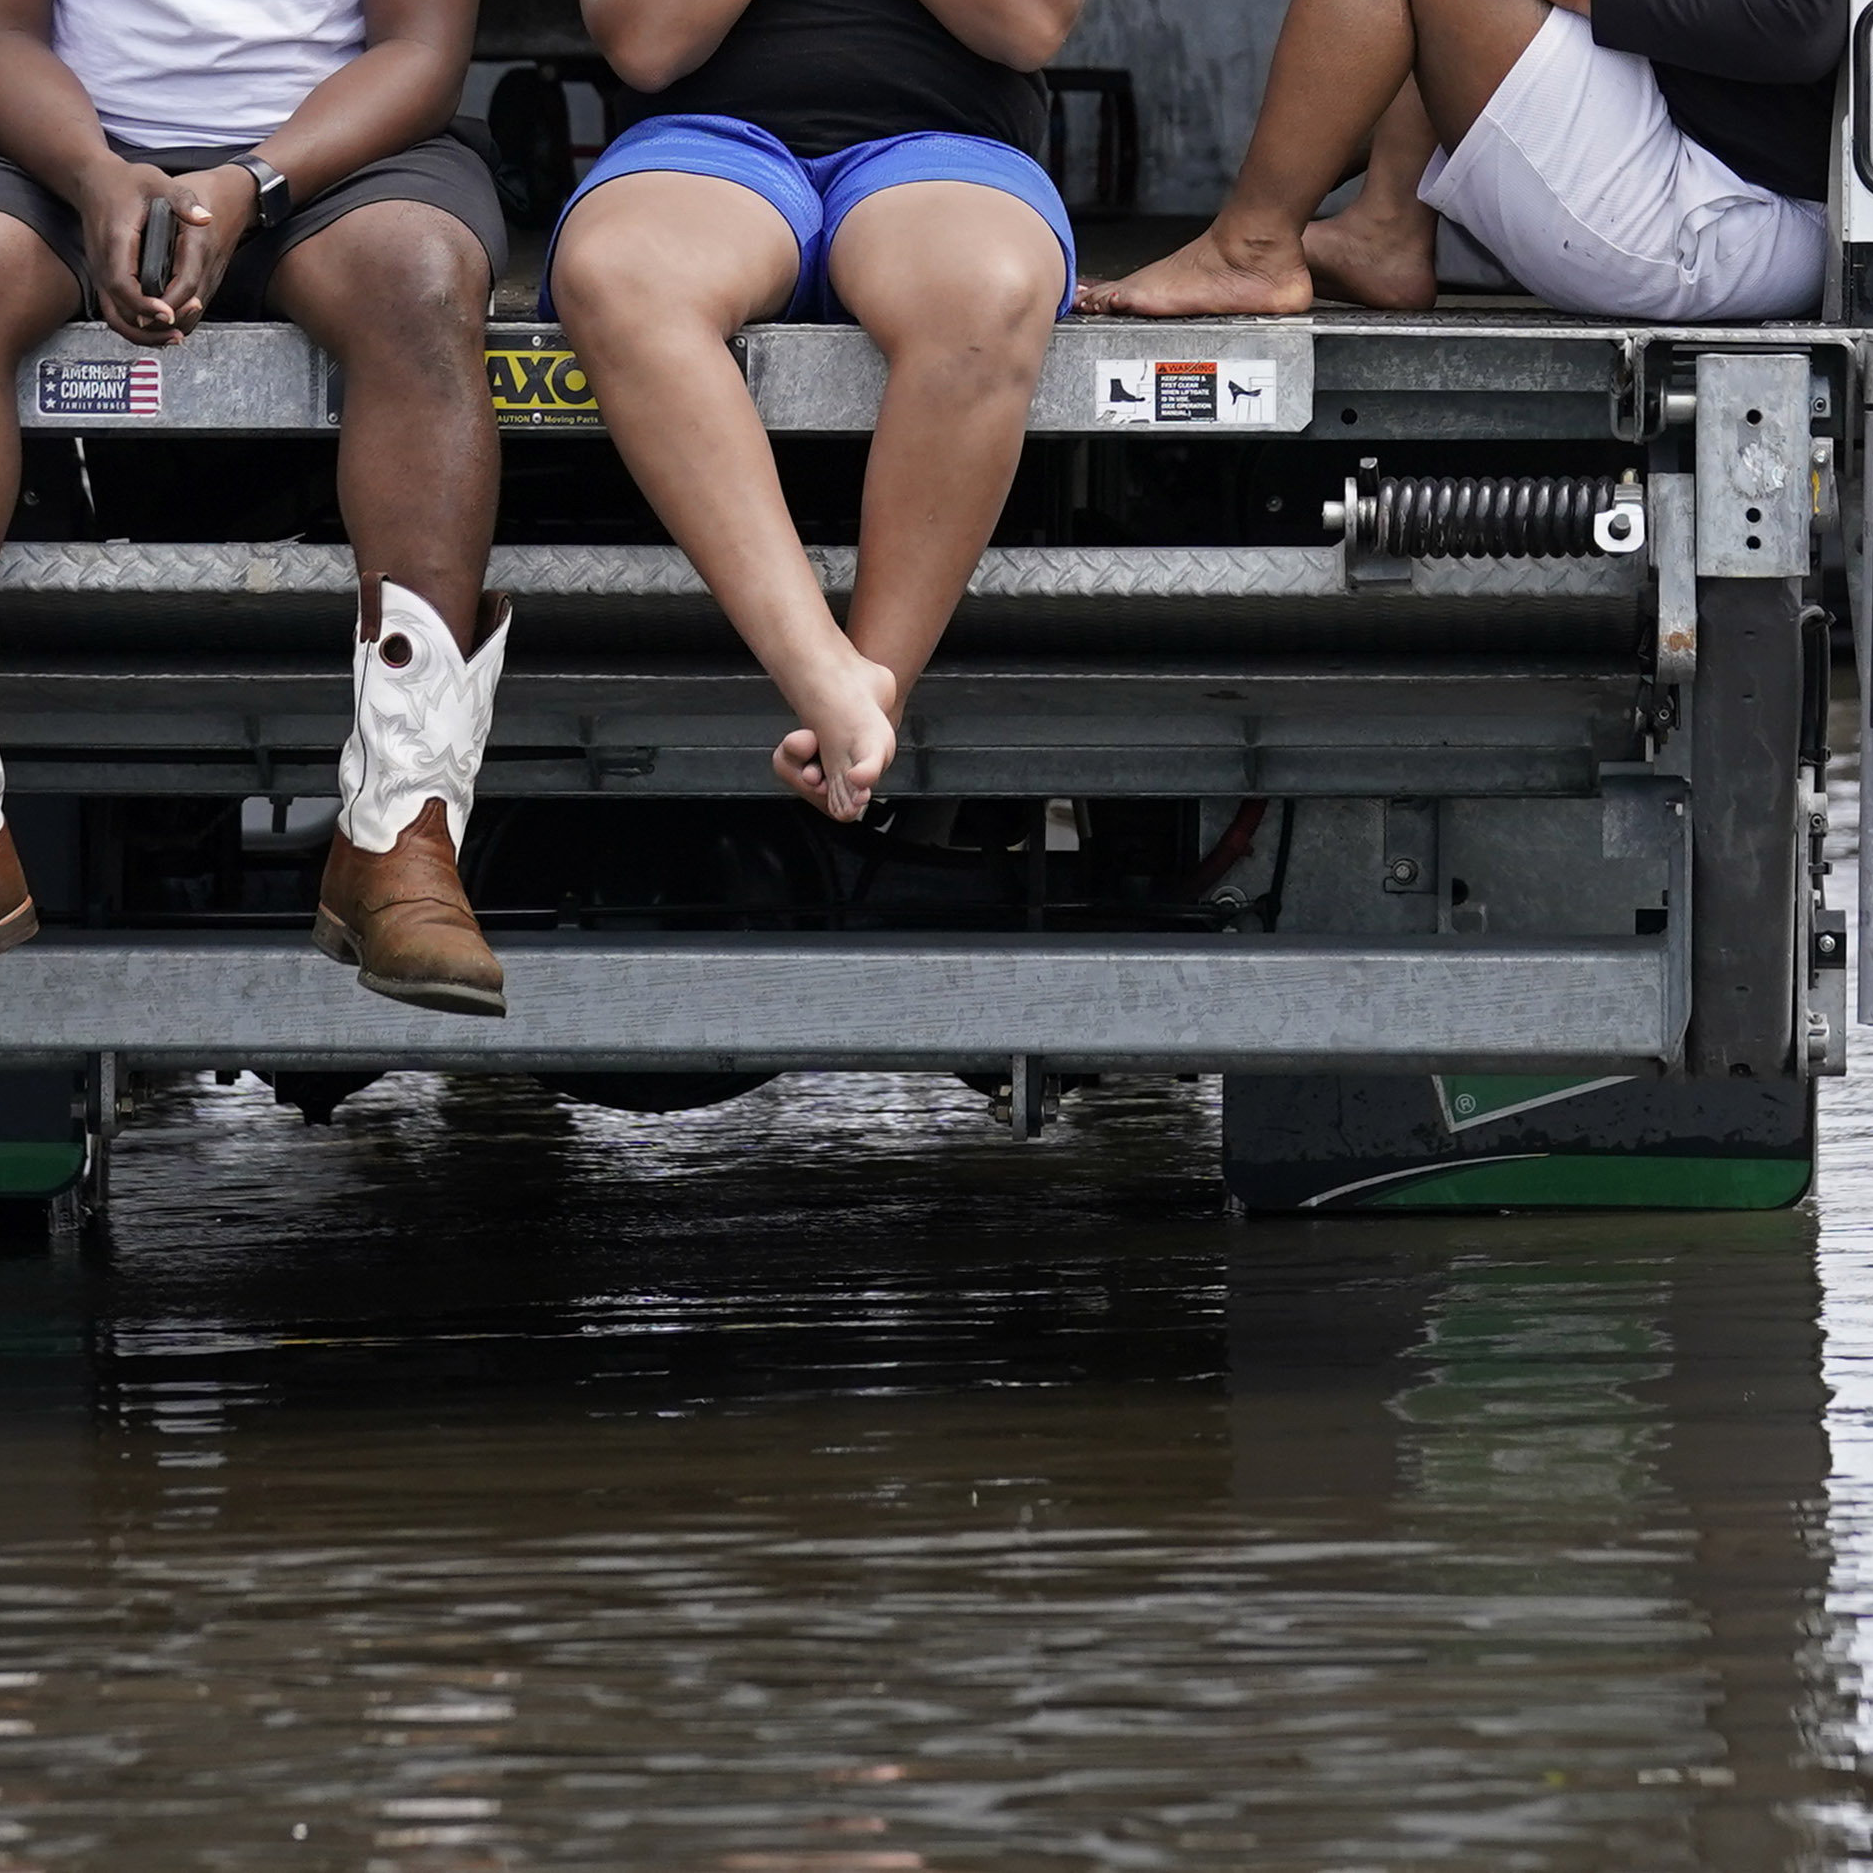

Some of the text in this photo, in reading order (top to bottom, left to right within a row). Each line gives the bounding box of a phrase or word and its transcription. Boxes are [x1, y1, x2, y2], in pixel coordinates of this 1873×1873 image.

[62, 364, 127, 380] AMERICAN
[486, 356, 595, 404] AXO
[60, 381, 126, 399] COMPANY
[61, 402, 126, 410] FAMILY OWNED
[498, 415, 530, 423] AUTION
[544, 415, 575, 424] Moving
